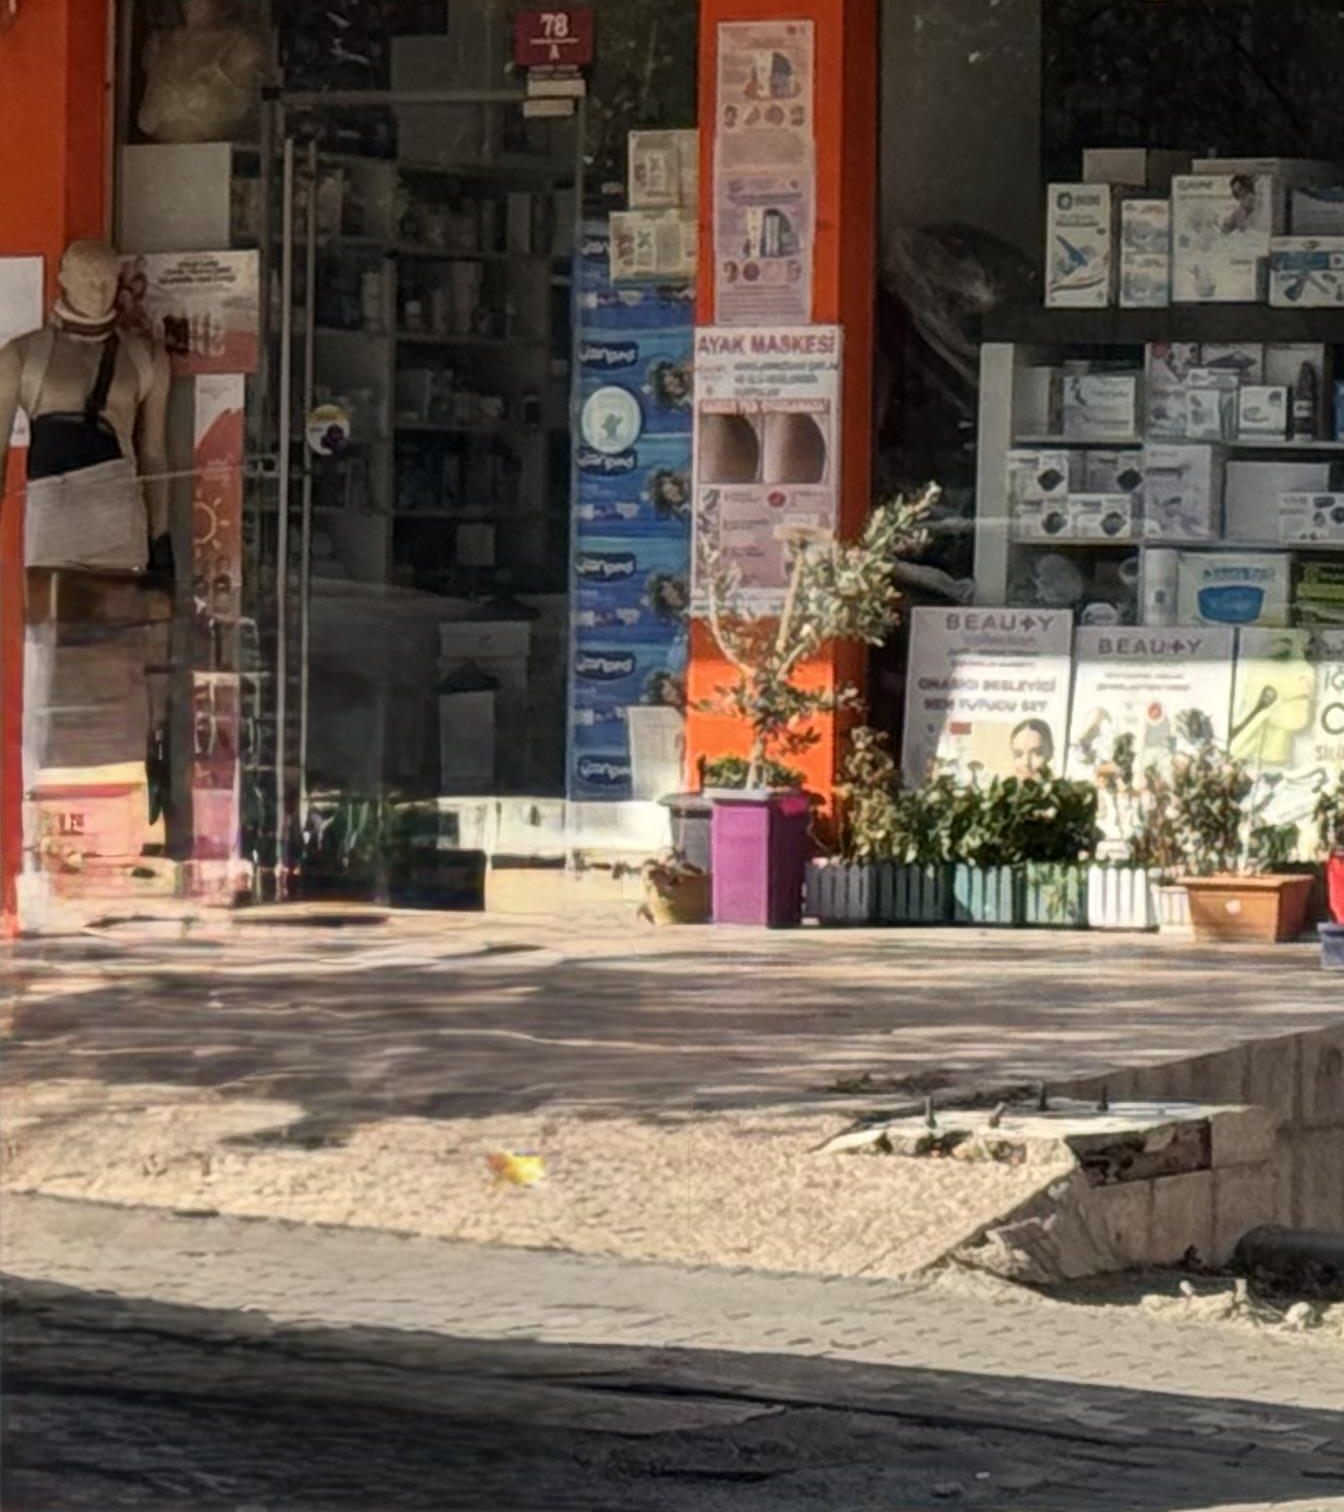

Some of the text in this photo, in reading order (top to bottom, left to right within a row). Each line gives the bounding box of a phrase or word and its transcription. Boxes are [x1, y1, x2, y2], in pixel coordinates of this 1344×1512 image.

[539, 12, 568, 37] 78
[697, 333, 835, 356] AYAK MASKESİ
